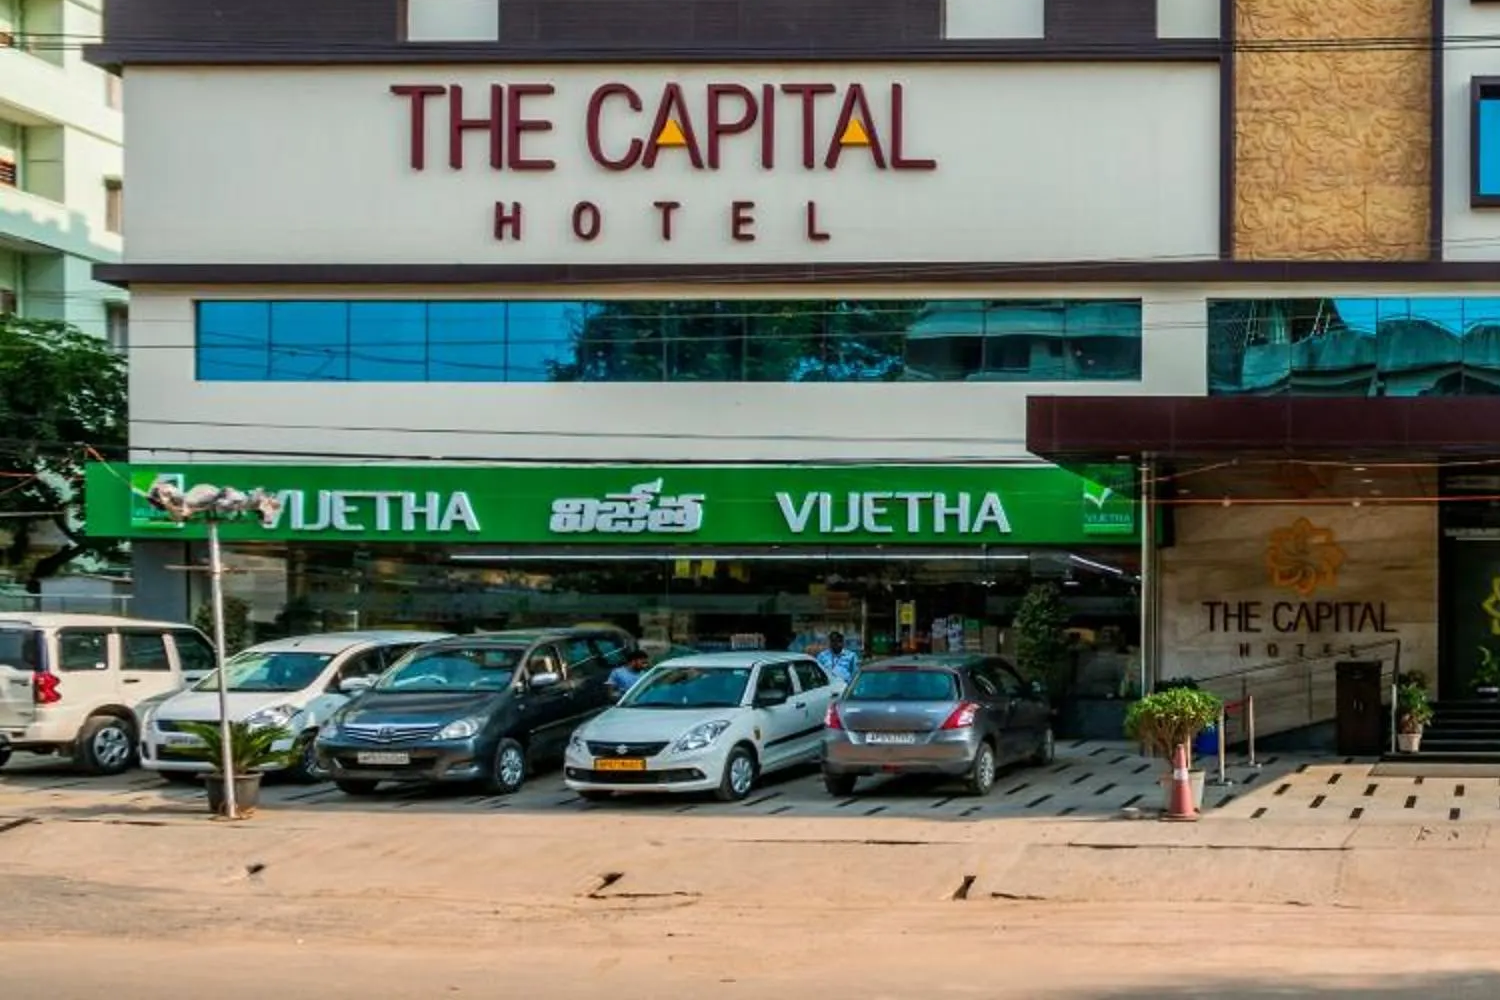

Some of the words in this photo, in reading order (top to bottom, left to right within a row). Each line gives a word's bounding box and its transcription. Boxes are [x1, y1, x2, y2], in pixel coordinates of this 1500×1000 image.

[389, 82, 556, 171] THE
[586, 82, 937, 171] CAPITAL
[493, 200, 831, 241] HOTEL
[549, 476, 706, 533] విజేత
[775, 491, 1013, 534] VIJETHA
[1201, 601, 1263, 633] THE
[1272, 601, 1399, 633] CAPITAL
[1238, 643, 1361, 658] HOTEL
